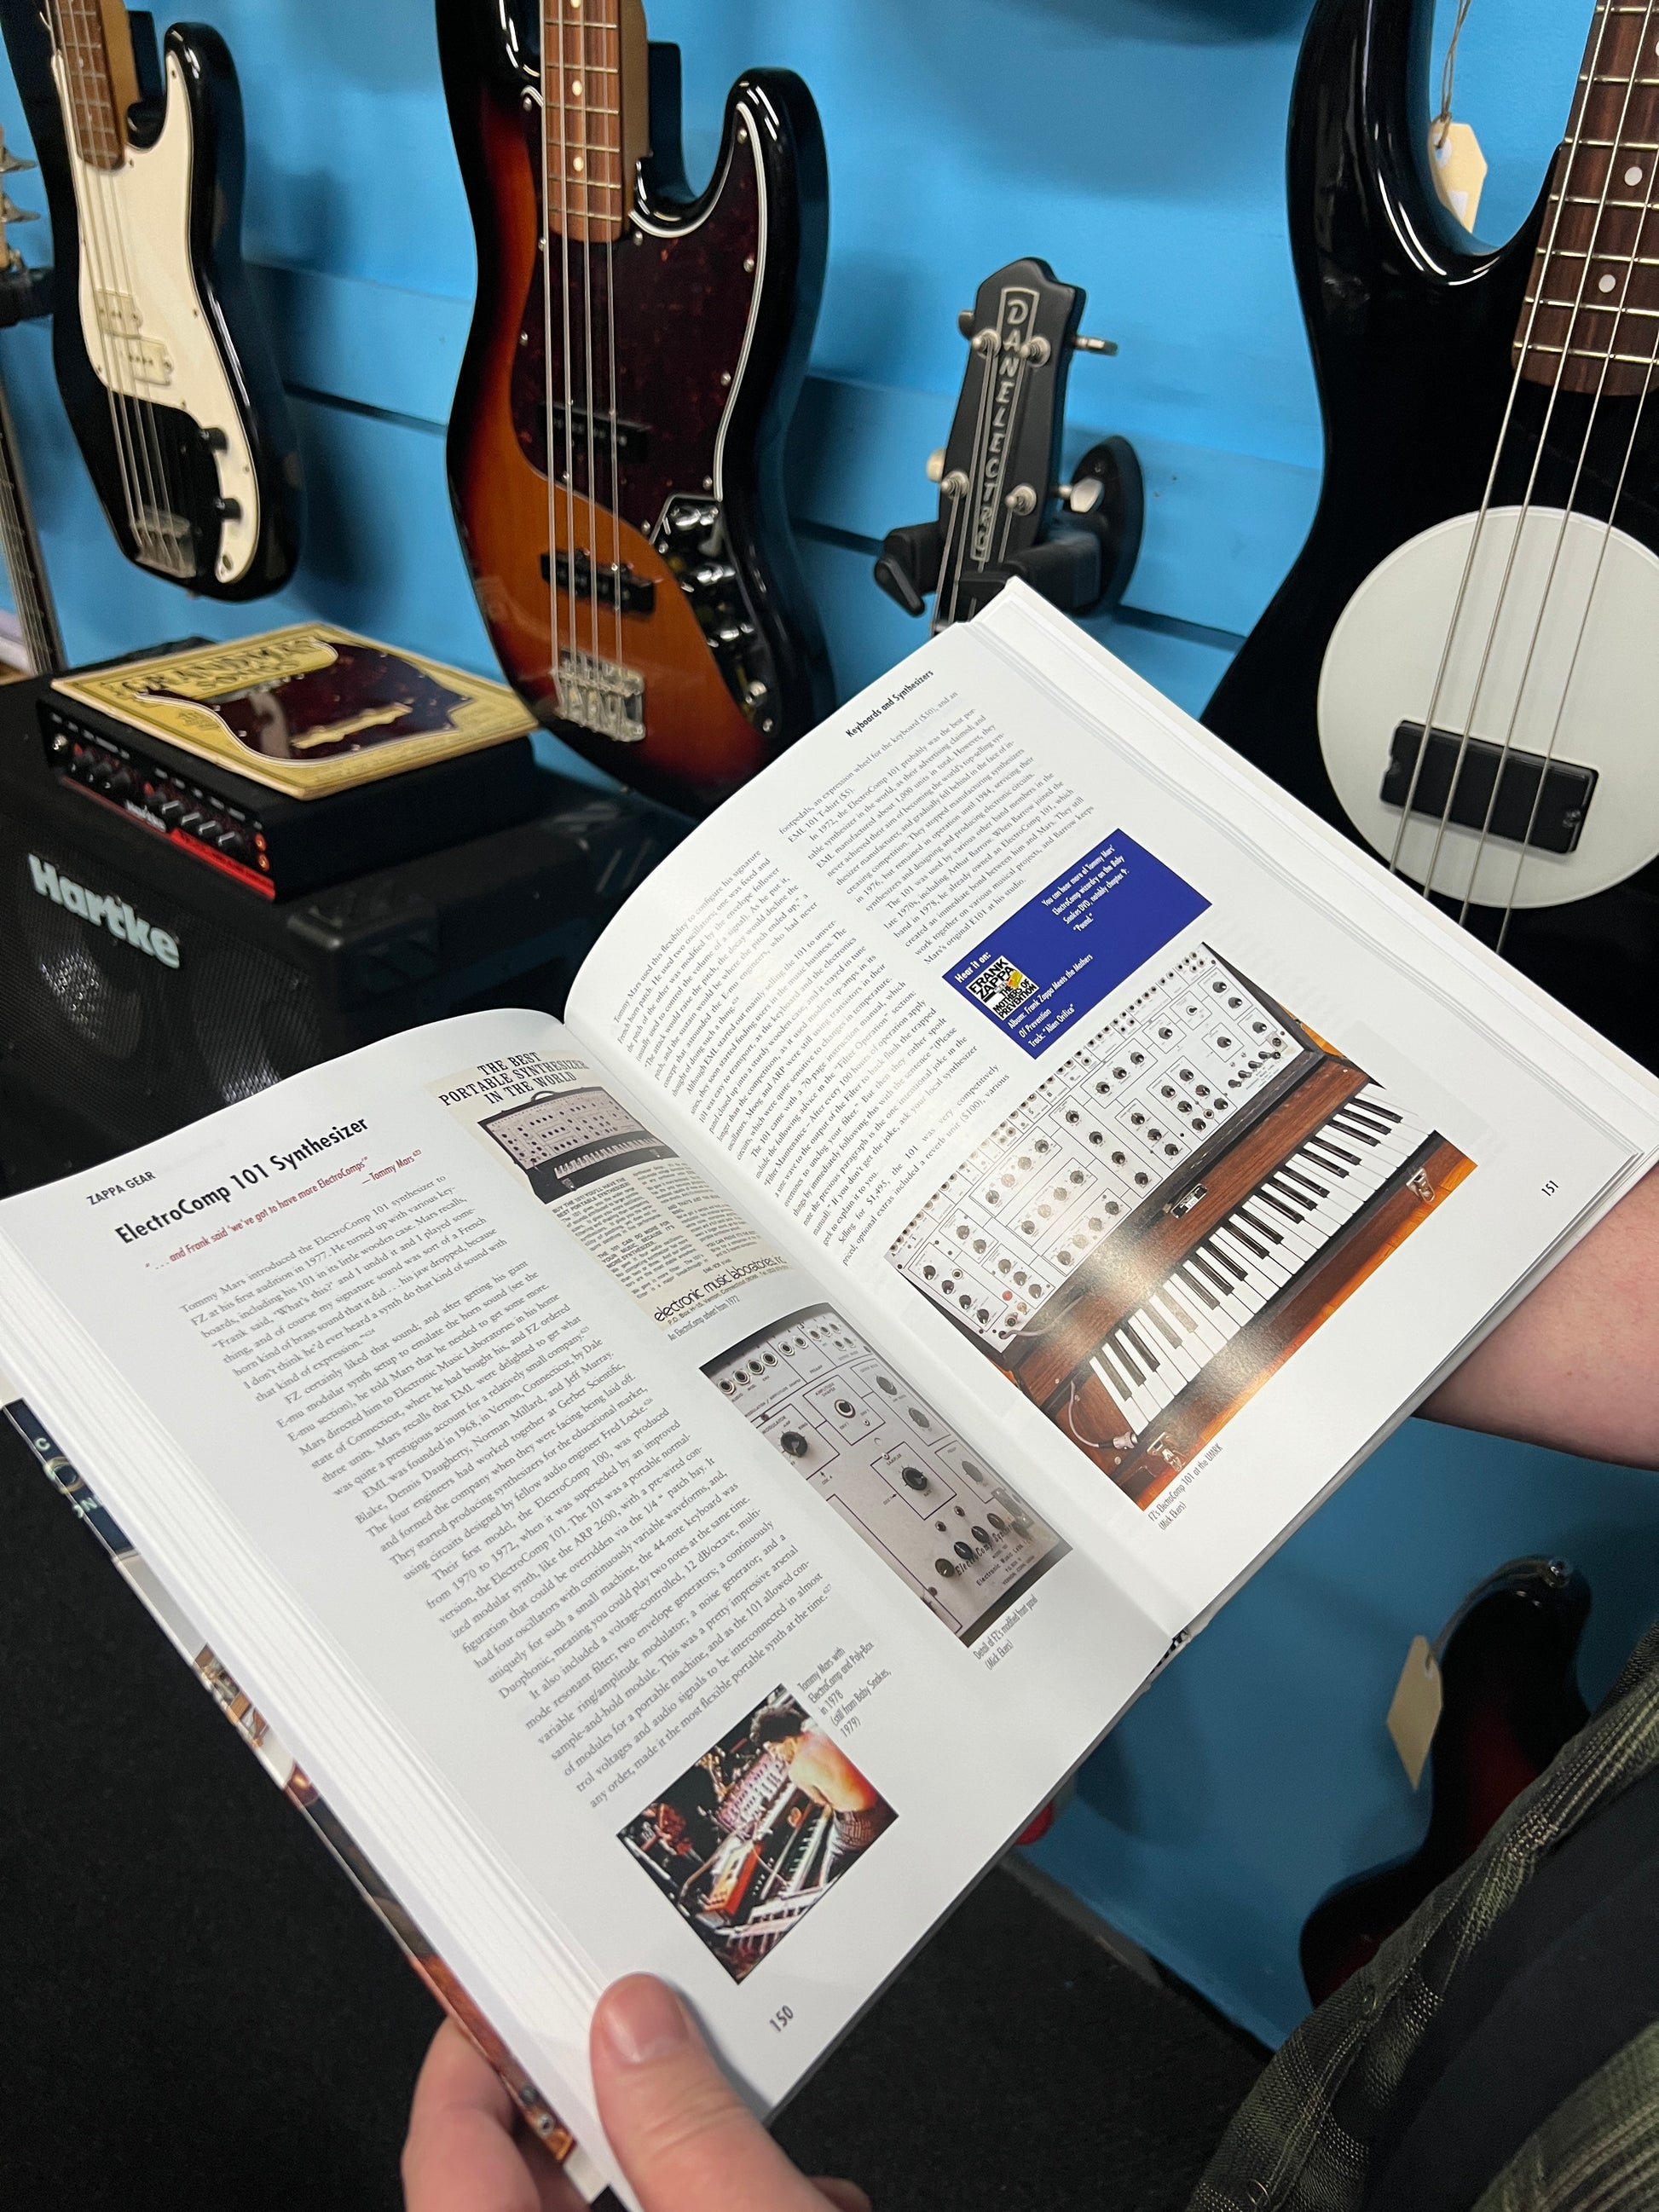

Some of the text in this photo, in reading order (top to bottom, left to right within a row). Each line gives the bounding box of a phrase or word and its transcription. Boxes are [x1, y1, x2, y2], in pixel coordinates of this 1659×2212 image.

[973, 298, 1030, 554] DANELECTRO
[845, 670, 934, 737] Keyboards and Synthesizers
[818, 818, 839, 834] 1972,
[836, 808, 848, 818] the
[847, 777, 887, 810] ElectroComp
[887, 765, 900, 777] 101
[900, 745, 928, 769] probably
[927, 736, 940, 746] was
[939, 727, 951, 736] the
[948, 717, 964, 729] best
[1069, 872, 1084, 884] more
[1081, 865, 1089, 875] of
[1084, 855, 1105, 870] Tommy
[1041, 897, 1054, 906] You
[1051, 855, 1124, 915] ElectroComp wizardry on the Baby
[1051, 890, 1062, 899] can
[1057, 881, 1072, 893] hear
[1062, 908, 1081, 924] Snakes
[1077, 899, 1093, 911] DVD,
[1090, 886, 1109, 902] notably
[1105, 872, 1124, 888] chapter
[28, 852, 180, 969] Hartke
[946, 922, 971, 946] original
[968, 909, 987, 925] E101
[987, 903, 995, 911] at
[992, 896, 1005, 904] his
[1004, 879, 1024, 896] studio.
[954, 951, 991, 983] Hear it on:
[968, 956, 1009, 994] FRANK
[976, 962, 1014, 1001] ZAPPA
[991, 978, 1031, 1013] MOTHERS OF
[997, 983, 1014, 997] THE
[997, 983, 1037, 1019] PREVENTION
[1007, 954, 1093, 1029] Album: Frank Zappa Meets the Mothers
[1018, 1008, 1052, 1038] Of Prevention
[1027, 1032, 1046, 1048] Track:
[477, 1052, 541, 1076] THE BEST
[437, 1059, 590, 1107] PORTABLE SYNTHESIZER
[483, 1071, 576, 1104] IN THE WORLD
[837, 1222, 856, 1245] Selling
[854, 1208, 865, 1220] for
[892, 1164, 903, 1175] the
[905, 1145, 918, 1159] 101
[957, 1064, 999, 1106] competitively
[85, 1171, 156, 1205] ZAPPA GEAR
[114, 1118, 368, 1244] ElectroComp 101 Synthesizer
[368, 1164, 396, 1181] Tommy
[1541, 1180, 1558, 1197] 151
[169, 1246, 186, 1262] and
[184, 1236, 211, 1254] Frank
[210, 1227, 228, 1242] said
[254, 1209, 269, 1222] got
[267, 1205, 278, 1214] to
[275, 1195, 298, 1209] have
[297, 1185, 319, 1199] more
[179, 1292, 218, 1313] Tommy
[218, 1279, 246, 1294] Mars
[247, 1250, 297, 1280] introduced
[298, 1245, 314, 1255] the
[313, 1214, 371, 1246] ElectroComp
[372, 1203, 389, 1216] 101
[390, 1181, 435, 1206] synthesizer
[654, 1288, 705, 1322] electronic
[702, 1273, 732, 1293] music
[725, 1295, 740, 1306] 1972
[1156, 1484, 1186, 1513] ElectroComp
[1181, 1472, 1194, 1486] 101
[1193, 1466, 1200, 1476] at
[1197, 1459, 1208, 1470] the
[1204, 1442, 1223, 1461] UMRK
[987, 1636, 996, 1647] of
[796, 1646, 846, 1692] Tommy Mars with
[807, 1671, 843, 1704] ElectroComp
[840, 1658, 853, 1674] and
[590, 1790, 607, 1808] any
[608, 1767, 636, 1792] order,
[633, 1745, 658, 1769] made
[656, 1737, 667, 1747] it
[665, 1725, 681, 1741] the
[679, 1705, 702, 1728] most
[699, 1679, 732, 1708] flexible
[731, 1649, 766, 1684] portable
[764, 1629, 788, 1652] synth
[786, 1621, 796, 1632] at
[794, 1610, 809, 1624] the
[824, 1689, 844, 1709] 1978
[853, 1686, 872, 1703] Baby
[840, 1715, 861, 1737] 1979)
[769, 2005, 794, 2032] 150
